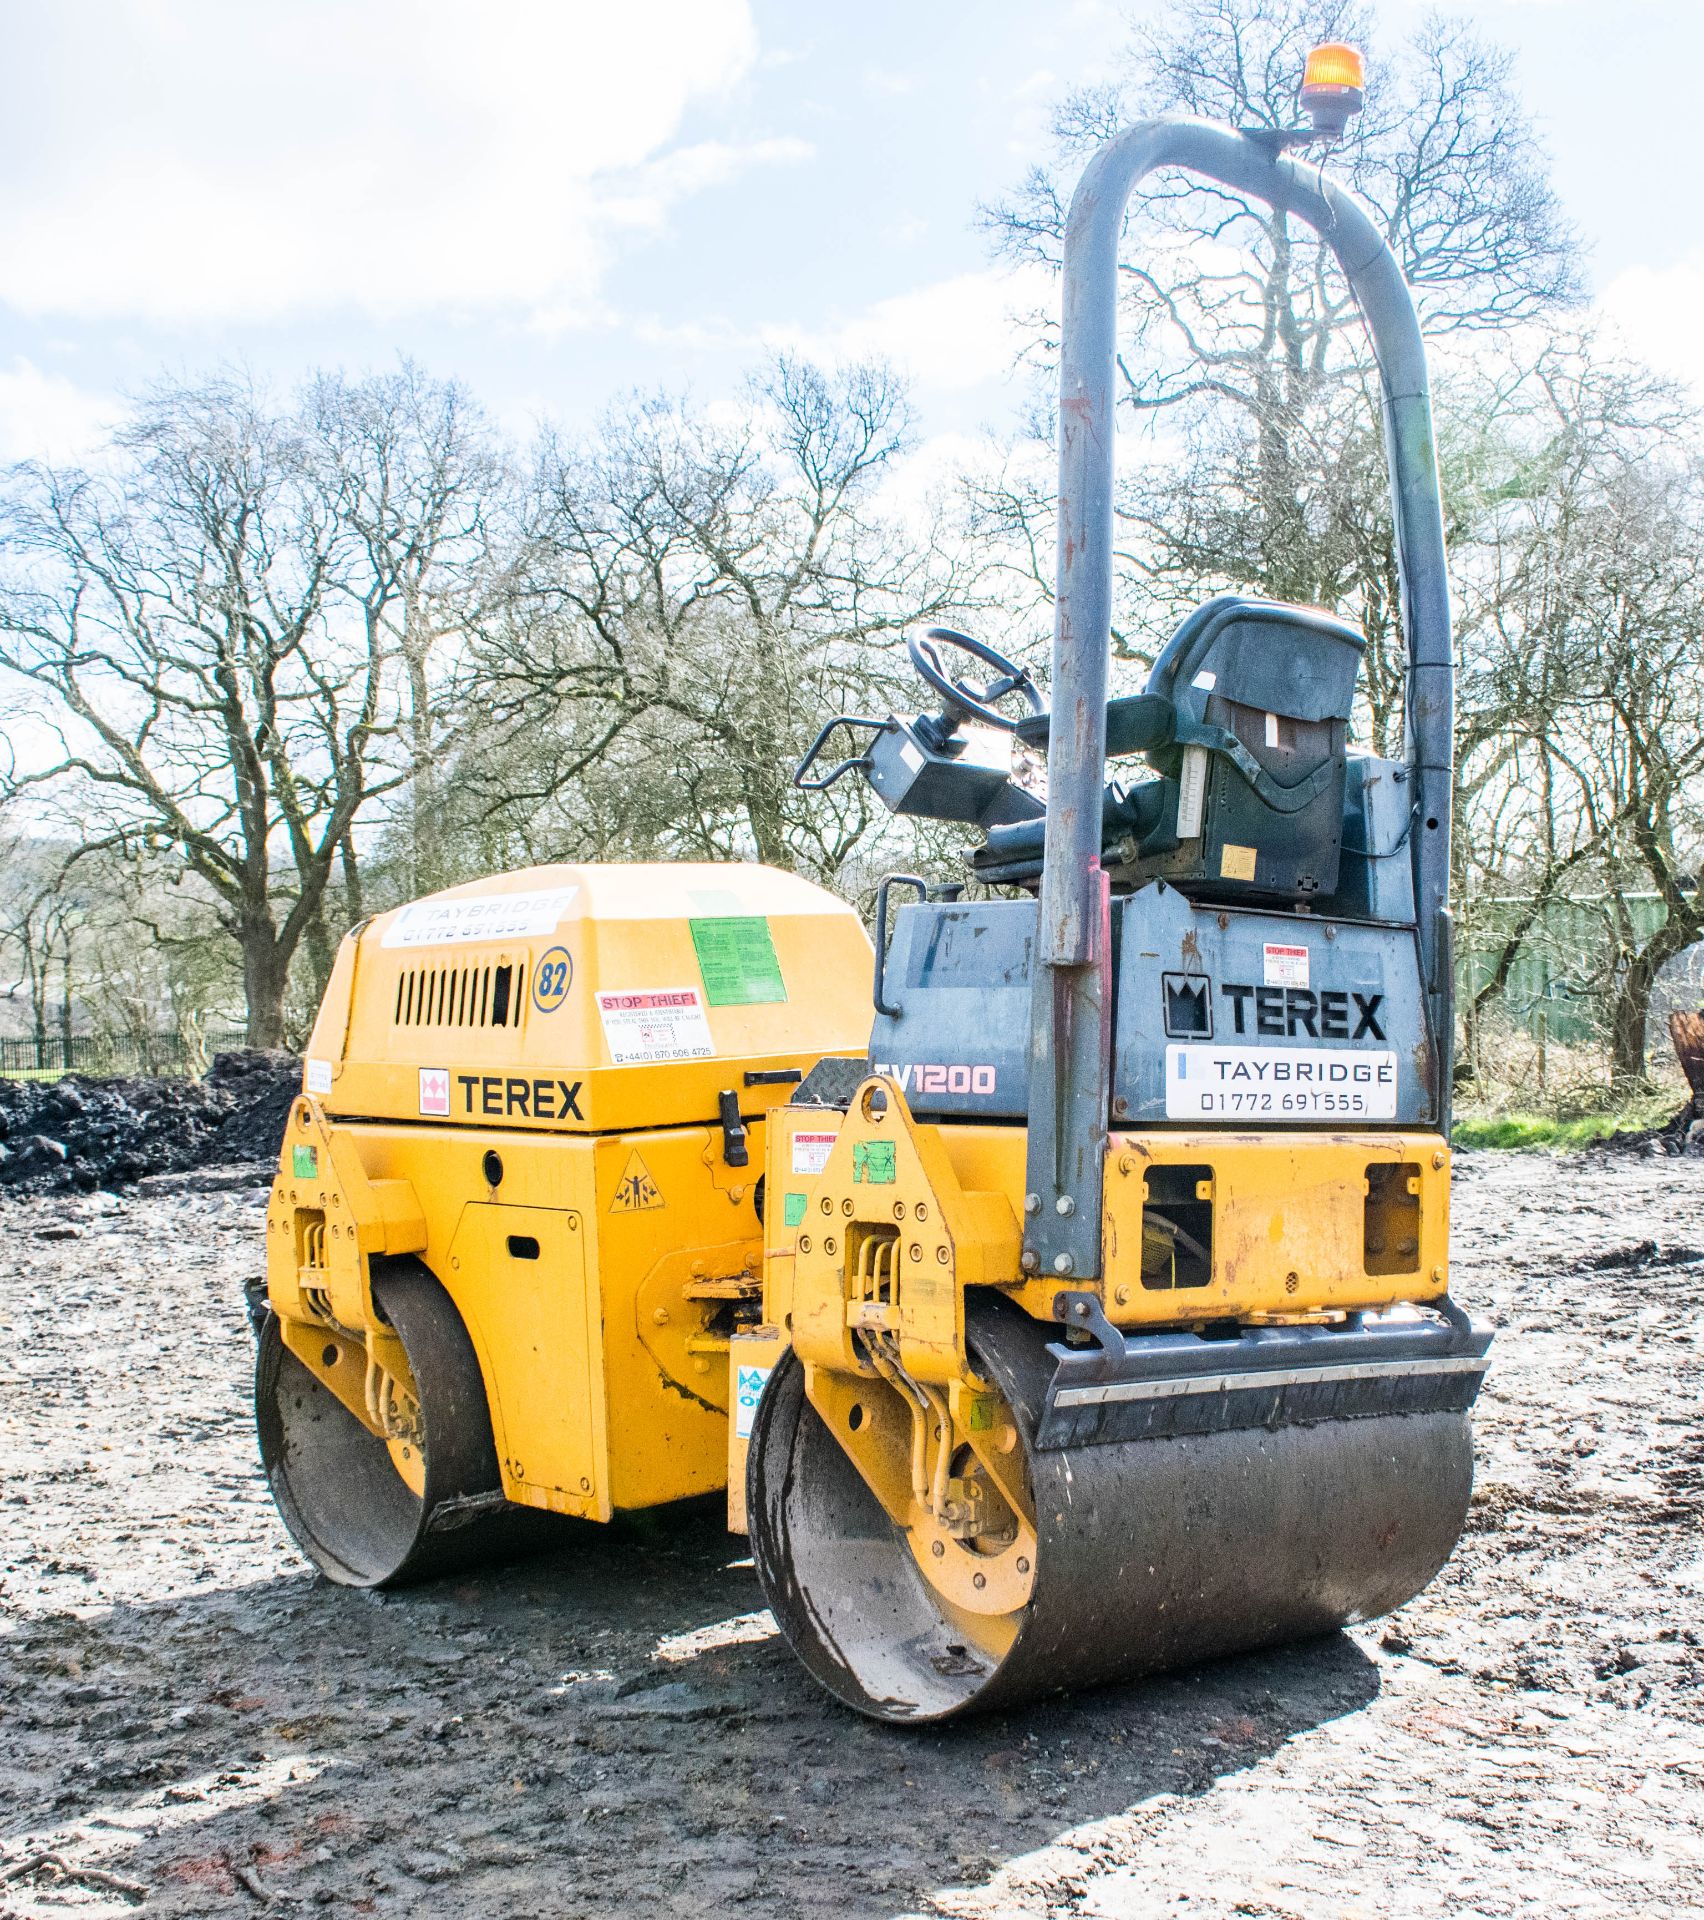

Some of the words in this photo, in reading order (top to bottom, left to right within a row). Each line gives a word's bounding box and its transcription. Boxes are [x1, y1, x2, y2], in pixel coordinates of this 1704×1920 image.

[426, 896, 570, 922] TAYBRIDGE
[1266, 947, 1284, 955] STOP
[538, 962, 567, 997] 82
[603, 996, 642, 1009] STOP
[647, 993, 697, 1007] THIEF!
[1221, 984, 1387, 1041] TEREX
[654, 1050, 671, 1059] 870
[672, 1049, 690, 1058] 606
[691, 1047, 712, 1056] 4725
[1213, 1061, 1393, 1083] TAYBRIDGE
[457, 1076, 584, 1121] TEREX
[1201, 1094, 1272, 1111] 01772
[1282, 1093, 1363, 1111] 691555
[795, 1135, 814, 1143] STOP
